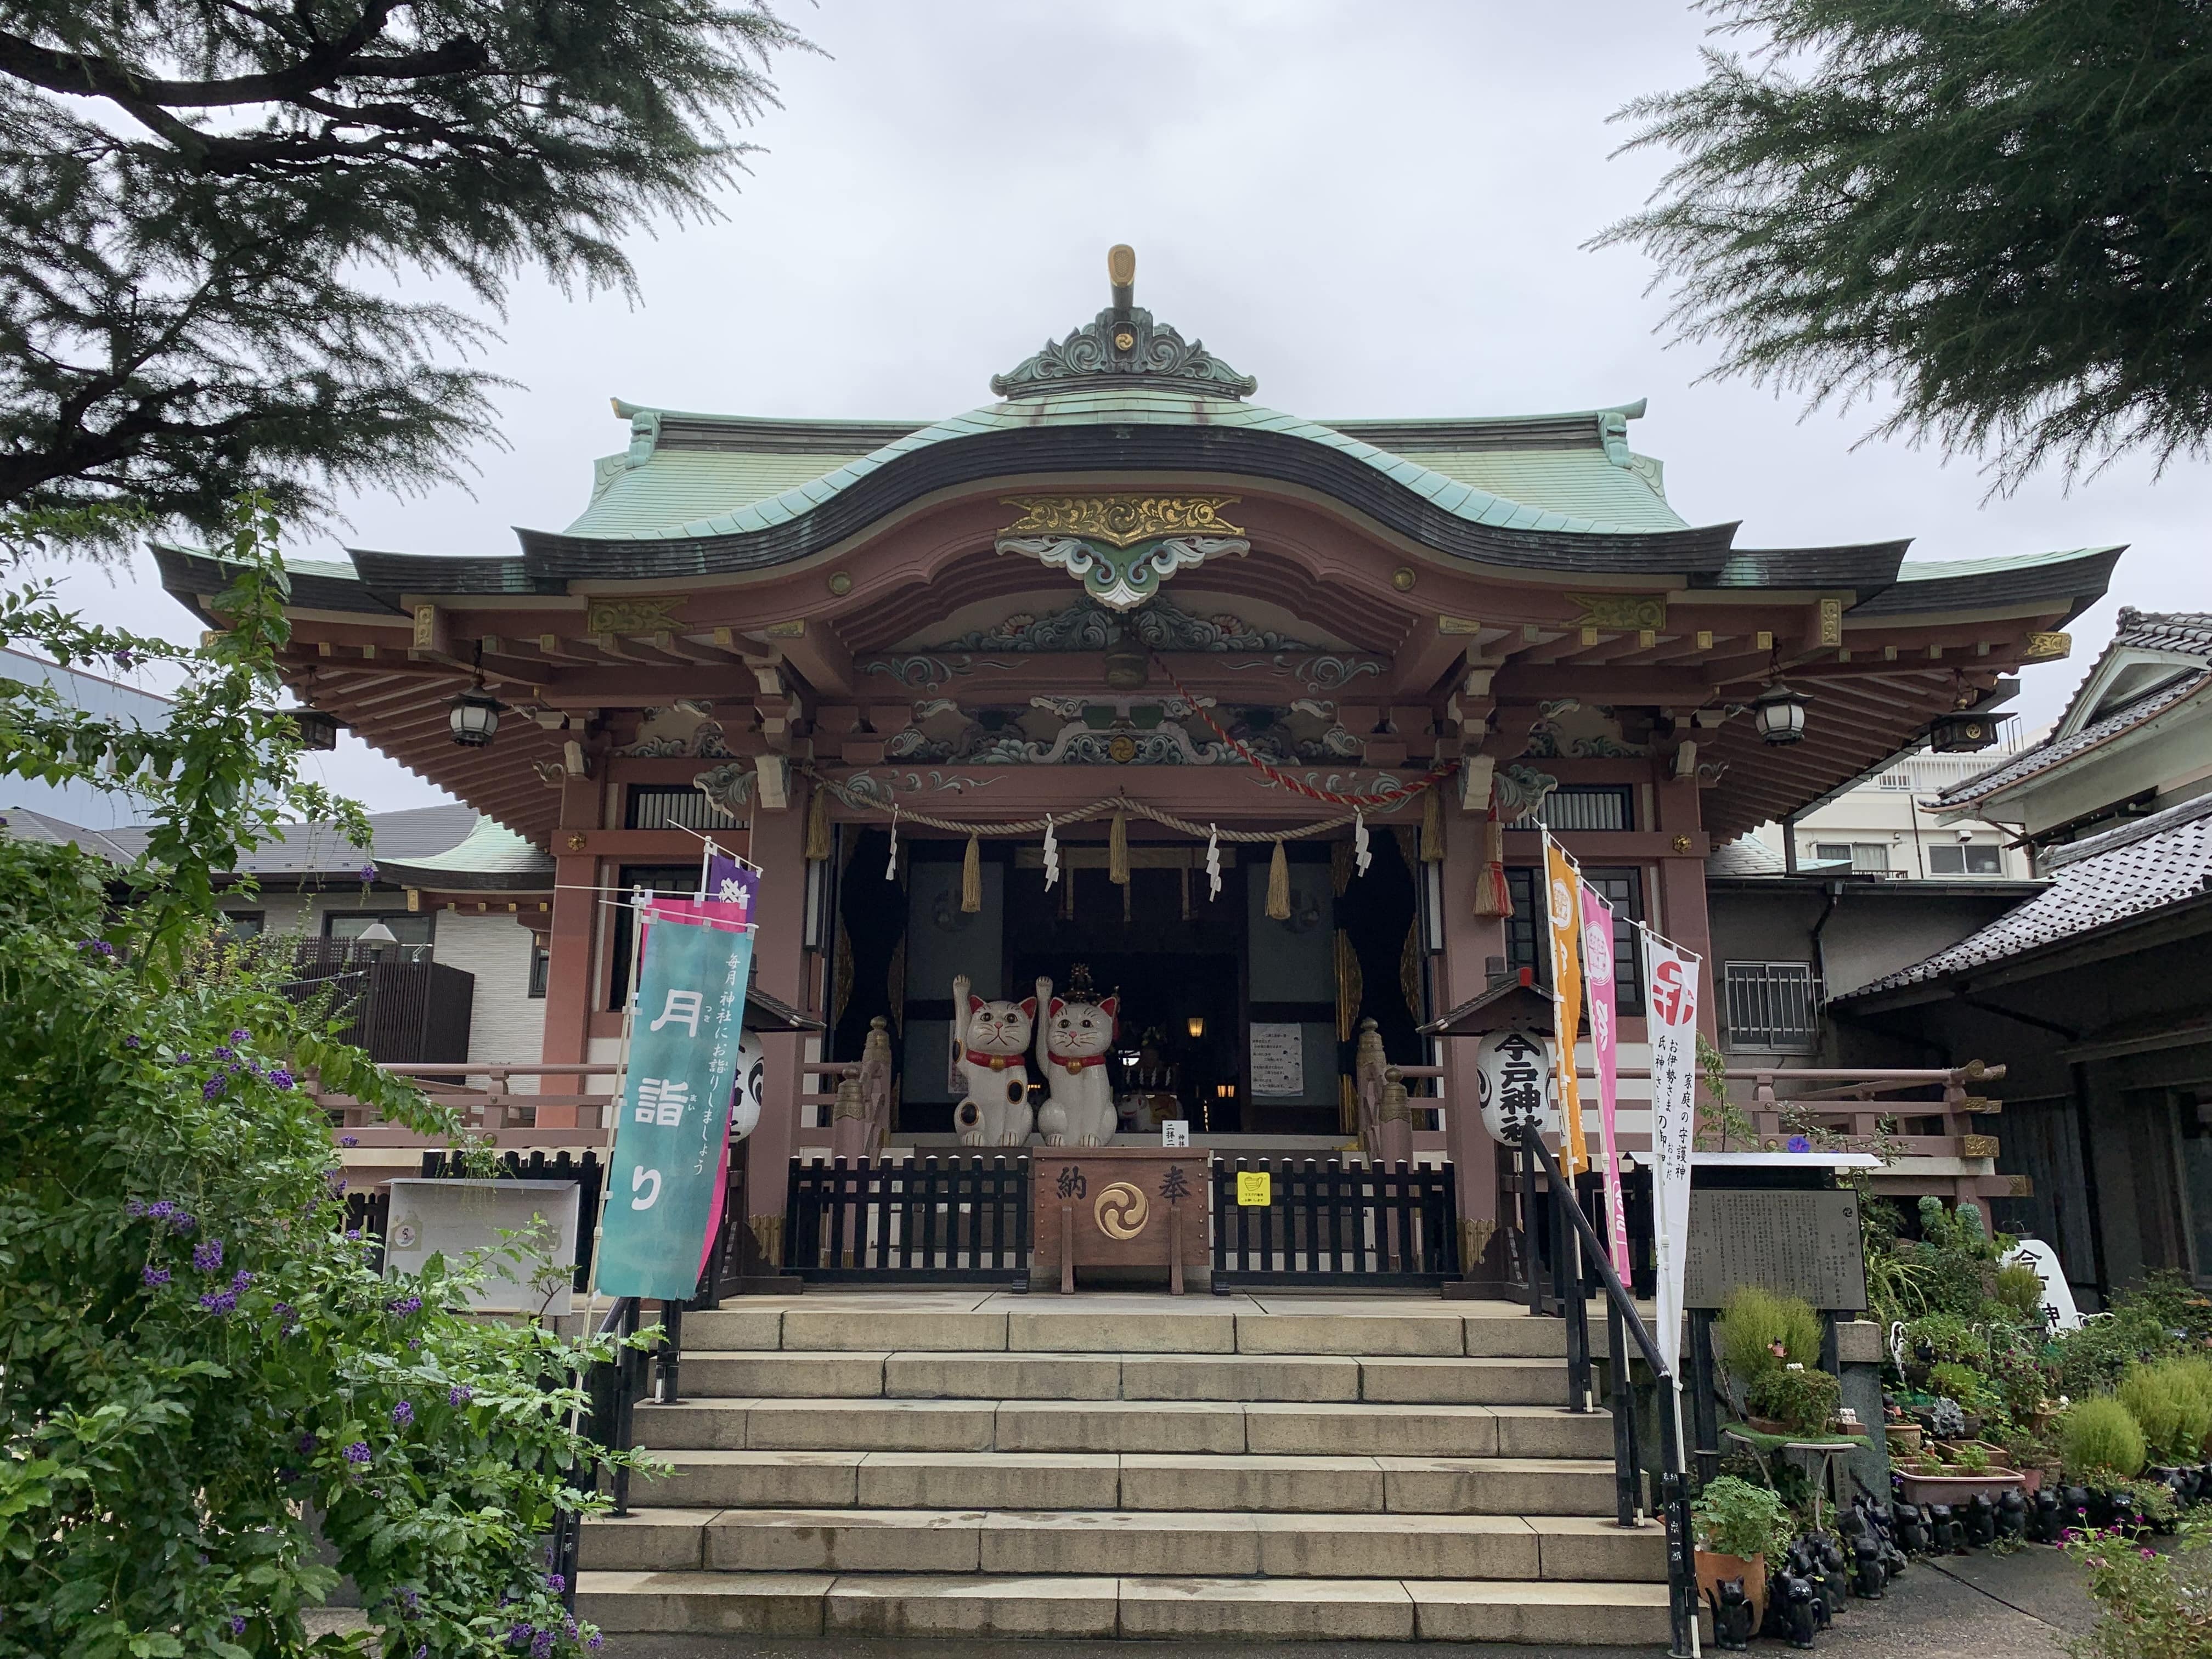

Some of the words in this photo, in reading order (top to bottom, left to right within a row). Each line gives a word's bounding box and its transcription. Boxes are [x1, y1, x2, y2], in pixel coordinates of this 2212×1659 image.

[631, 989, 703, 1211] 月詣り
[1494, 1034, 1542, 1142] 今戸神社
[1666, 1039, 1678, 1113] お伊勢さま
[1675, 1073, 1693, 1181] 家庭の守護神
[1056, 1165, 1087, 1200] 納
[1159, 1165, 1192, 1205] 奉
